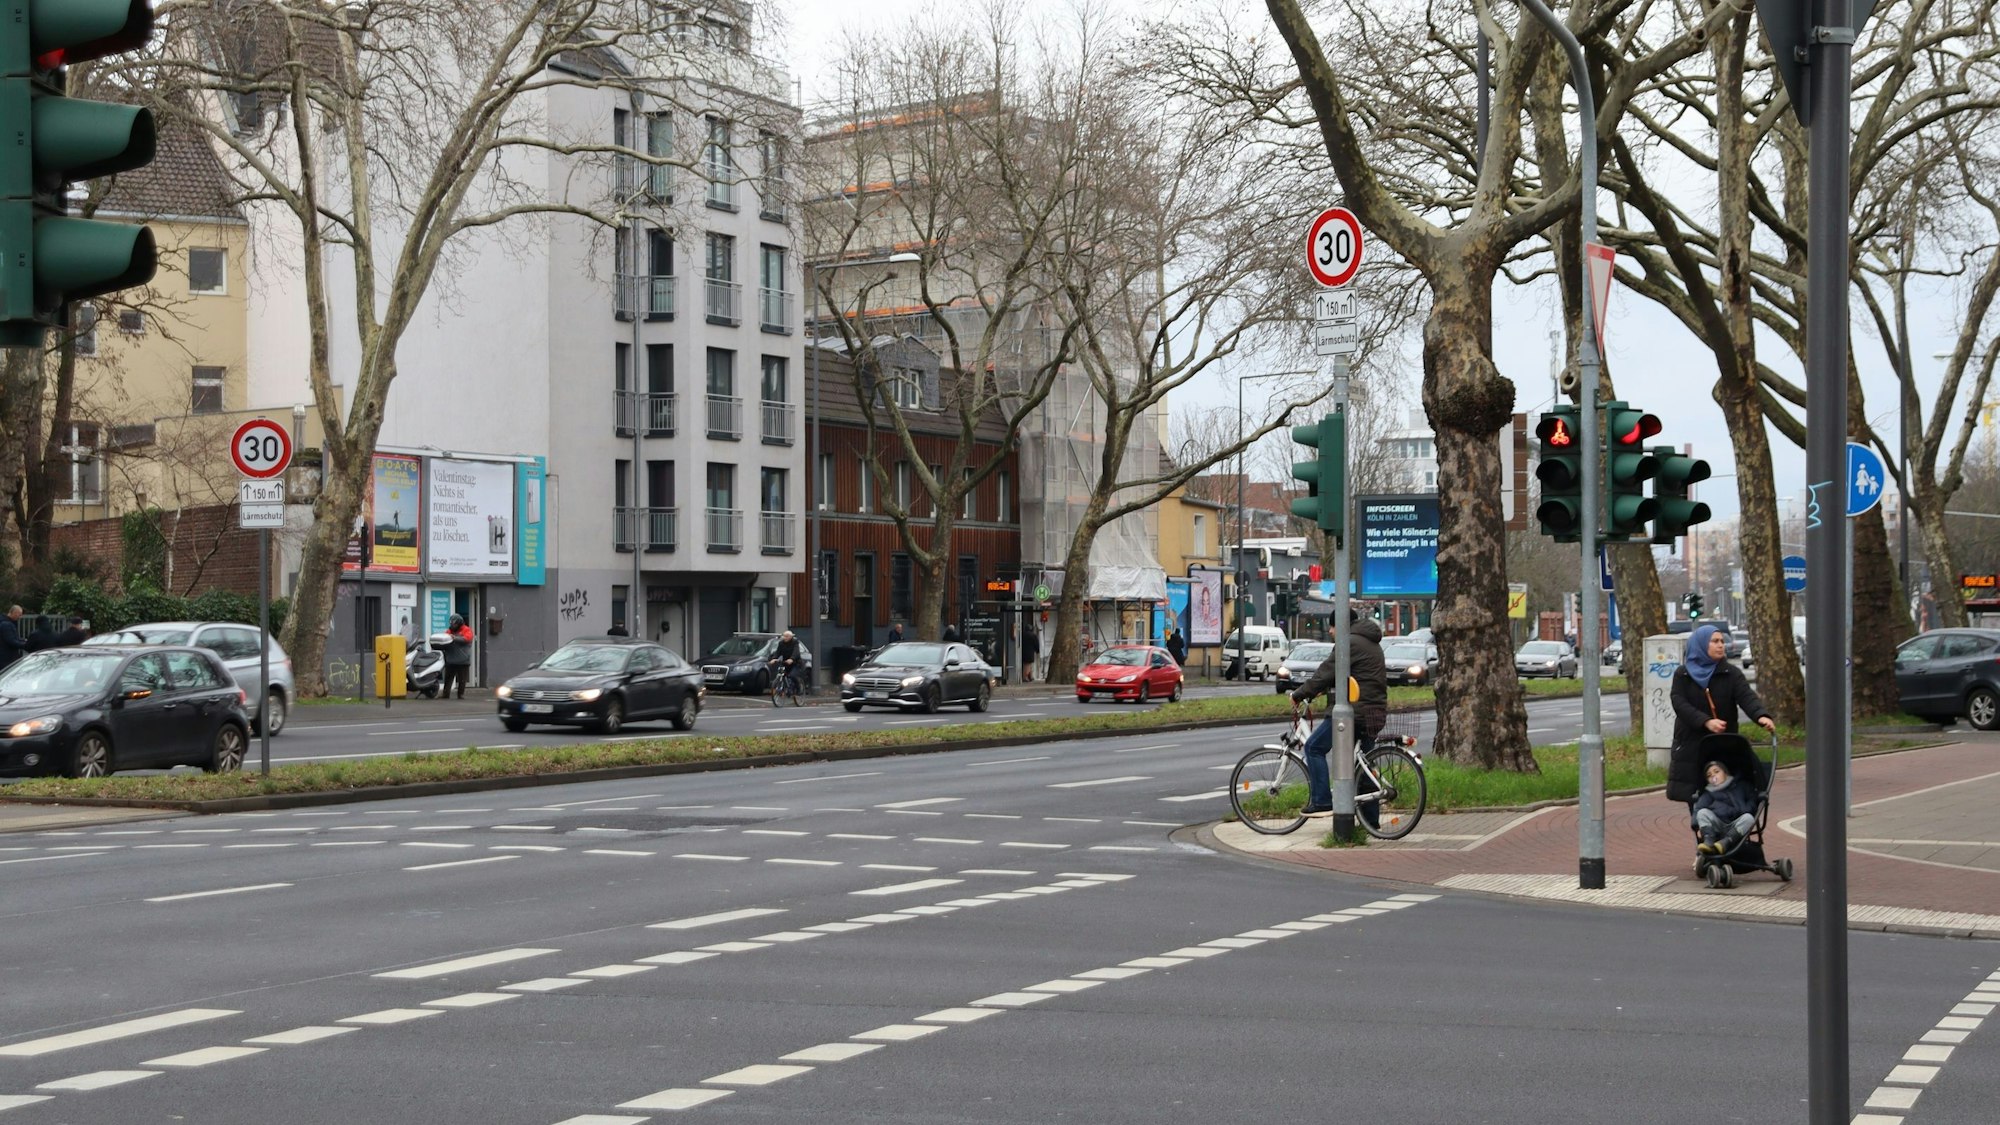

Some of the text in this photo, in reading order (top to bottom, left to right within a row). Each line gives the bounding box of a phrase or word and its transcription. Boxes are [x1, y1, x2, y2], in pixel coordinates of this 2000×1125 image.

[1318, 229, 1350, 266] 30
[1326, 301, 1348, 316] 150 m
[1317, 334, 1355, 347] Lärmschutz
[244, 435, 278, 462] 30
[253, 489, 276, 500] 150 m
[433, 485, 465, 499] Nichts ist
[243, 512, 282, 520] Lärmschutz
[432, 515, 458, 527] als uns
[1367, 514, 1384, 522] KÖLN
[432, 531, 442, 541] zu
[1366, 528, 1381, 537] Wie
[1382, 528, 1401, 537] viele
[1366, 538, 1419, 548] berufsbedingt
[1420, 538, 1428, 546] in
[1366, 549, 1409, 558] Gemeinde?
[431, 555, 447, 568] Hinge
